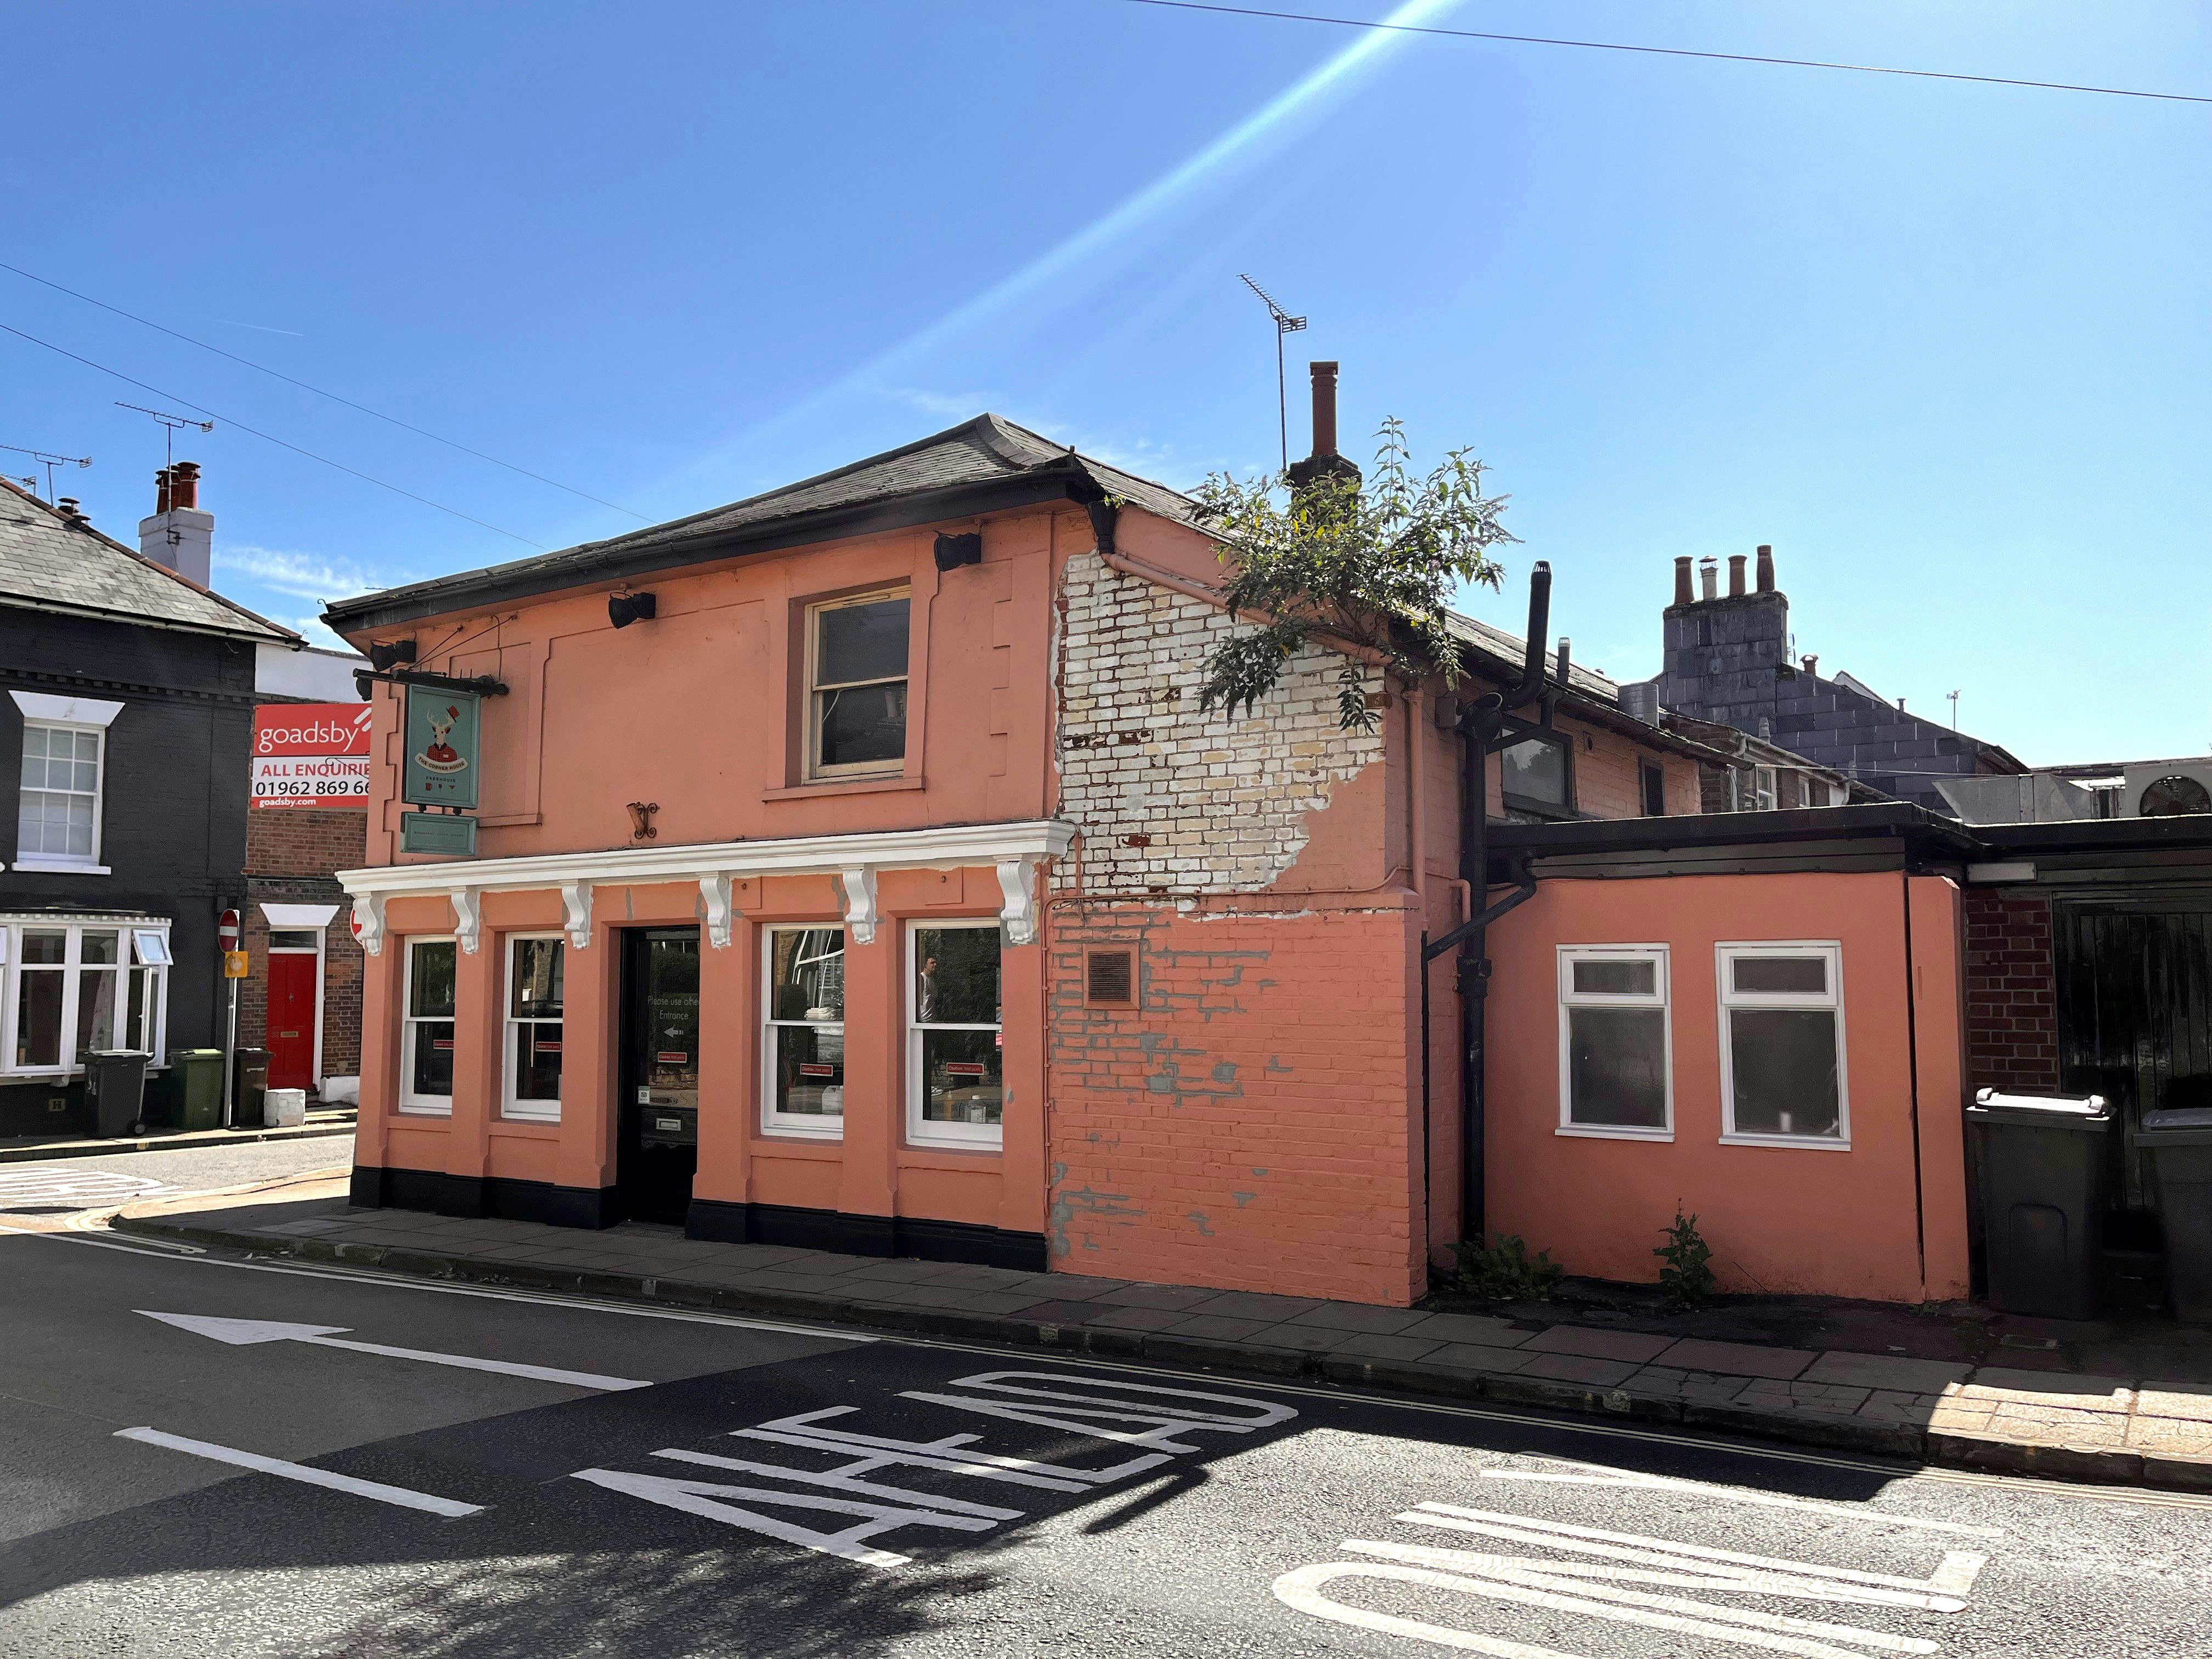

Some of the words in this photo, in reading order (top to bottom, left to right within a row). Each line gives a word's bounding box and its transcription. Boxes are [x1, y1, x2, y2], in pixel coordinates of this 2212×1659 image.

[258, 720, 358, 753] goadsby
[261, 764, 291, 777] ALL
[295, 763, 370, 777] ENQUIRIE
[419, 757, 428, 765] THE
[449, 760, 465, 770] HOUSE
[255, 782, 310, 795] 01962
[315, 781, 348, 795] 869
[258, 797, 317, 808] goadsby.com
[647, 995, 669, 1006] Please
[684, 996, 699, 1006] othe
[659, 1009, 689, 1020] Entrance
[569, 1370, 1299, 1568] AHEAD
